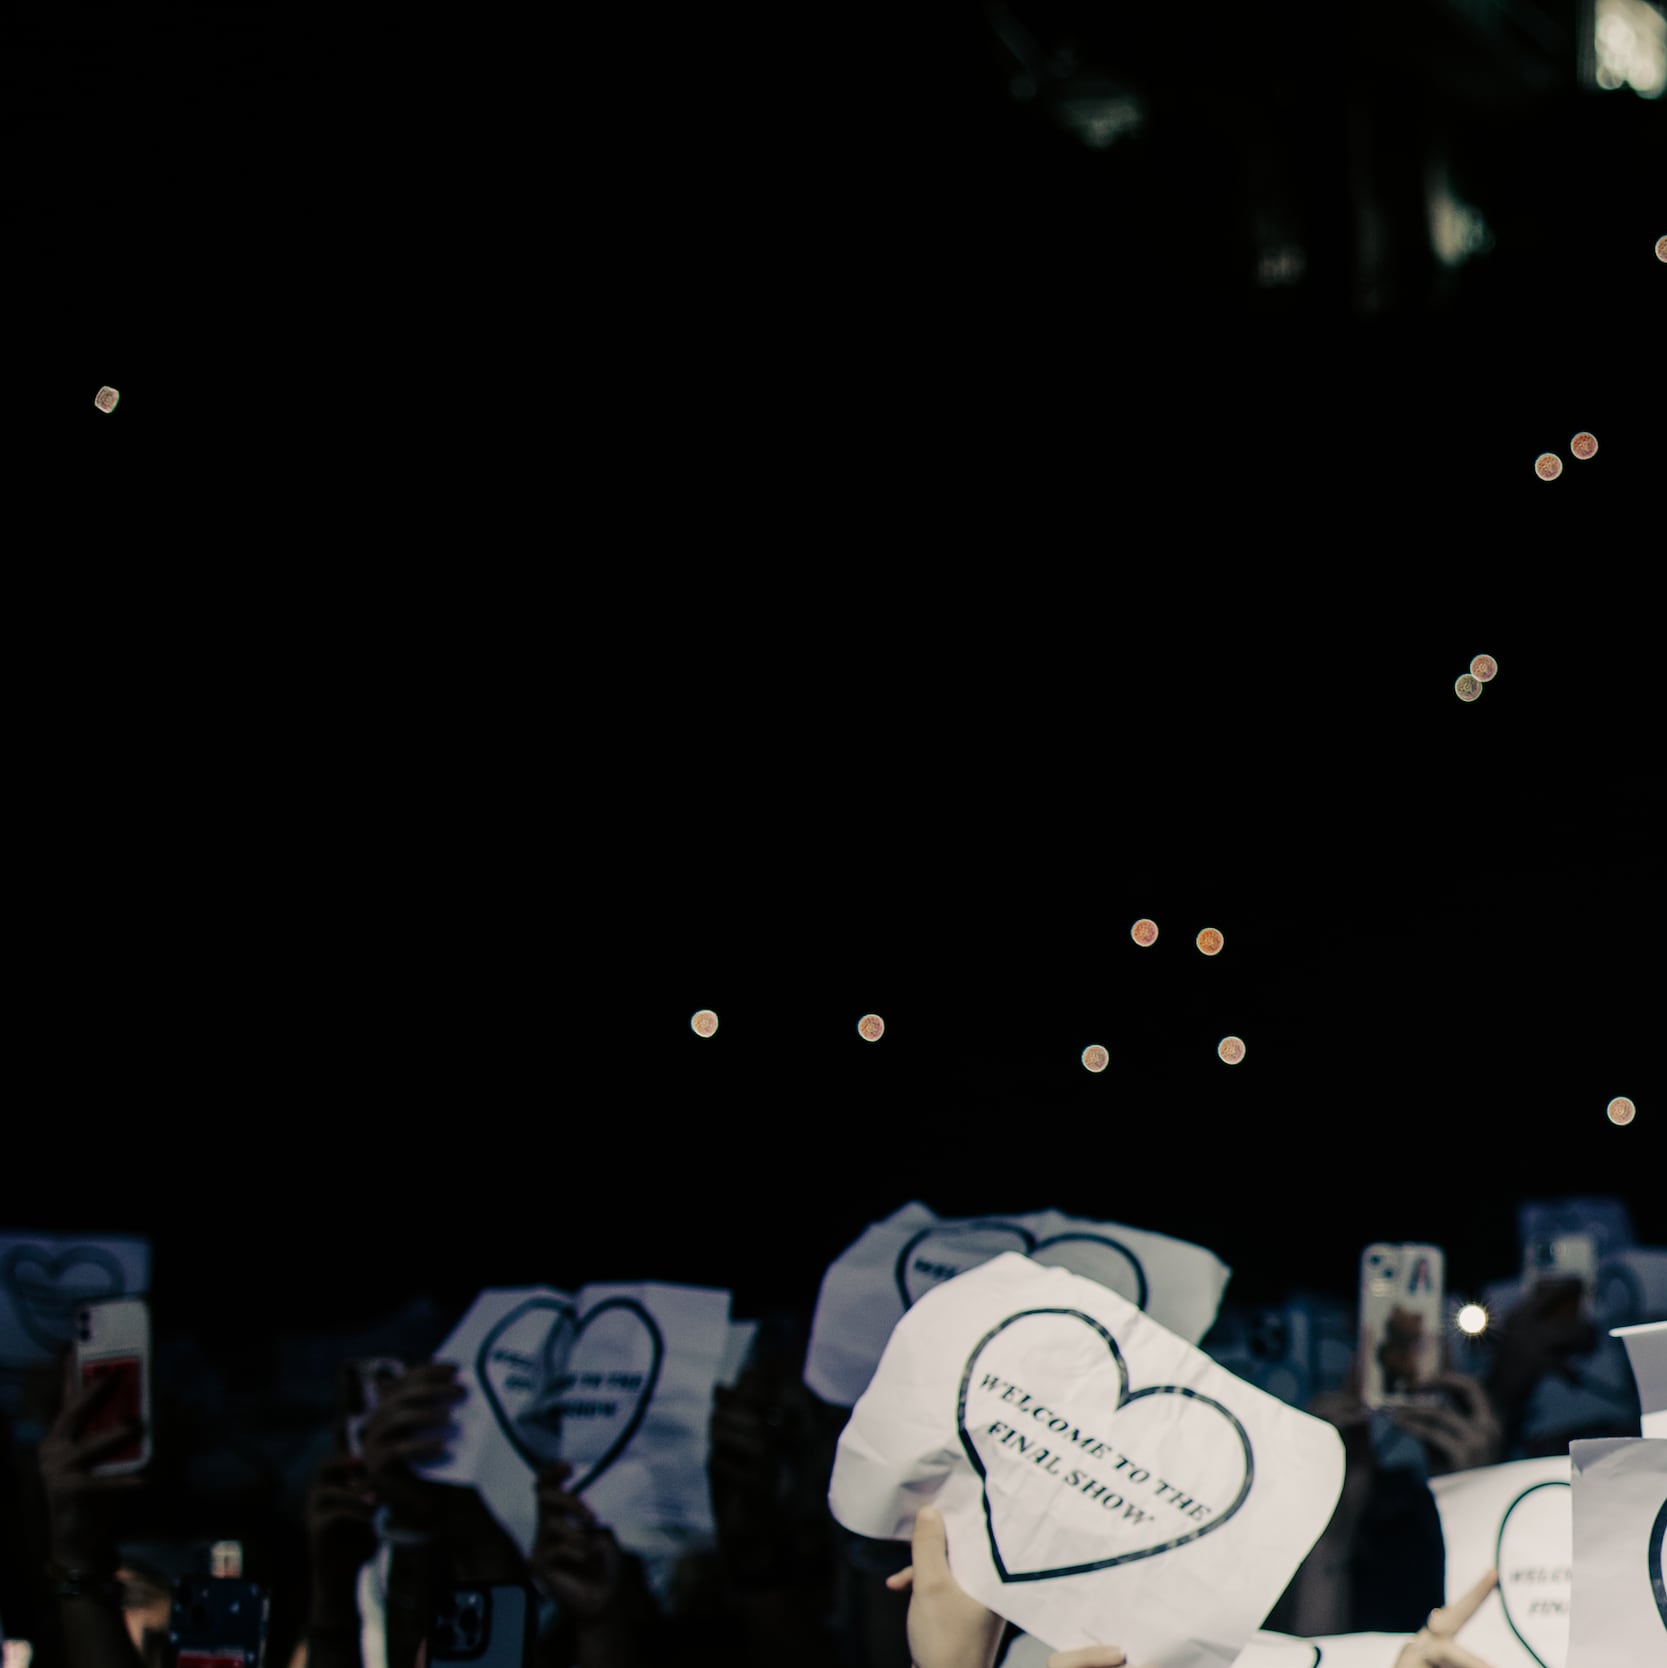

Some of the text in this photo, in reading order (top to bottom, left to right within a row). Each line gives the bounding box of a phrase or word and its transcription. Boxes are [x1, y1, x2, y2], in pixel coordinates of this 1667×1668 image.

[979, 1373, 1212, 1522] WELCOME TO THE
[986, 1421, 1155, 1527] FINAL SHOW
